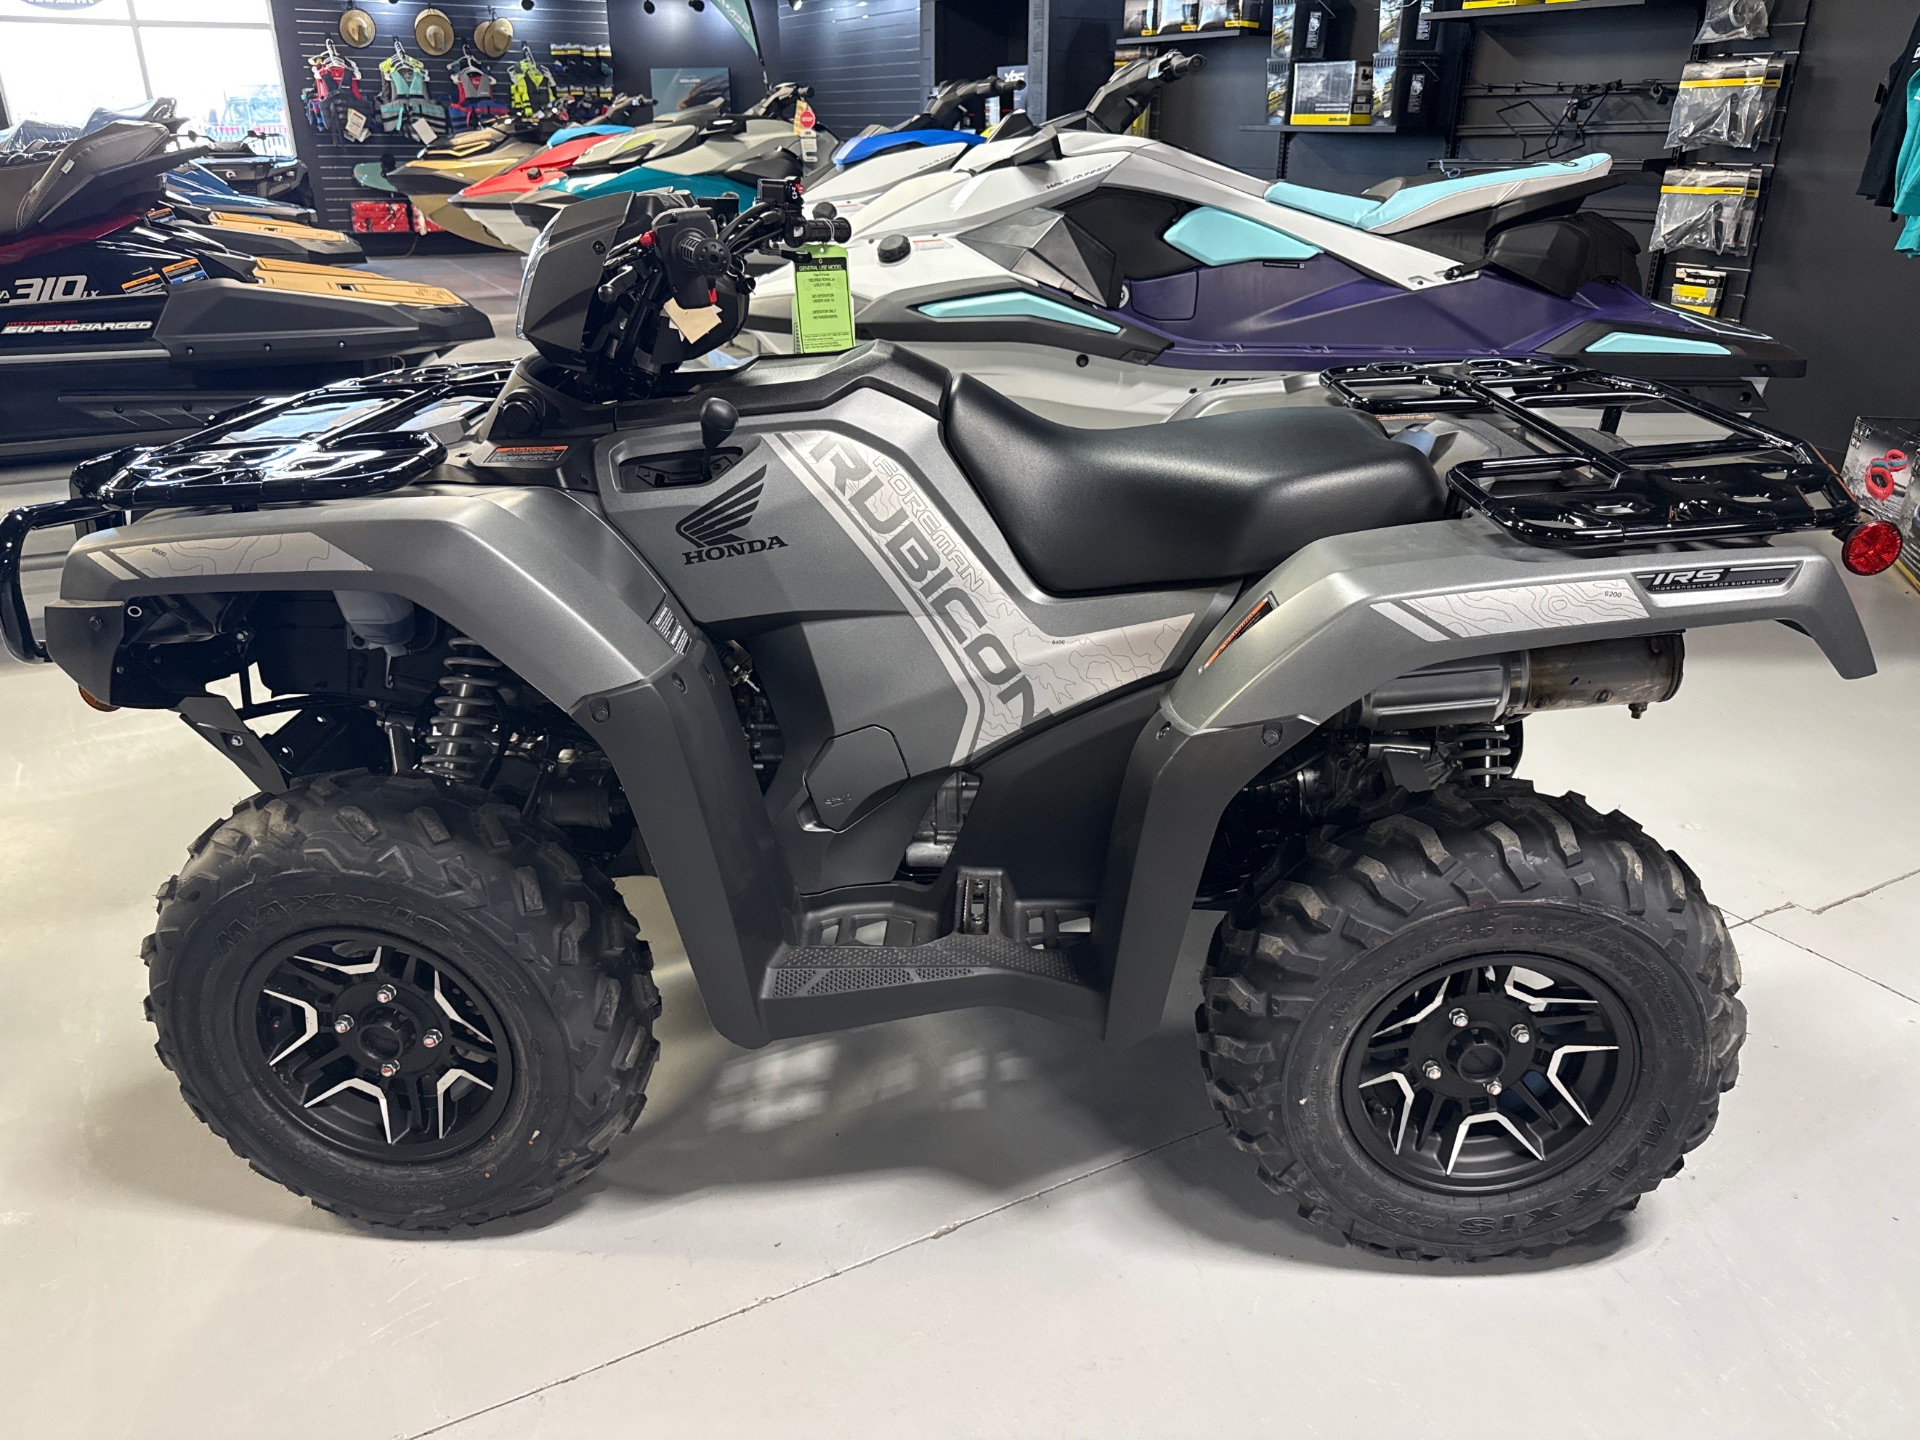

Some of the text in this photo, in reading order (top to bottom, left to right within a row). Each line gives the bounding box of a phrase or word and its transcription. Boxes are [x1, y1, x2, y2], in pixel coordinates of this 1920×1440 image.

[8, 274, 88, 302] 310
[0, 321, 153, 335] SUPERCHARGED
[872, 455, 984, 592] FOREMAN
[681, 535, 789, 565] HONDA
[809, 436, 1055, 733] RUBICON
[1652, 568, 1725, 586] IRS
[1652, 583, 1706, 591] INDEPENDENT
[1731, 578, 1780, 586] SUSPENSION
[1604, 590, 1623, 598] 6200
[215, 892, 457, 957] MAXXIS
[1459, 1099, 1668, 1237] MAXXIS
